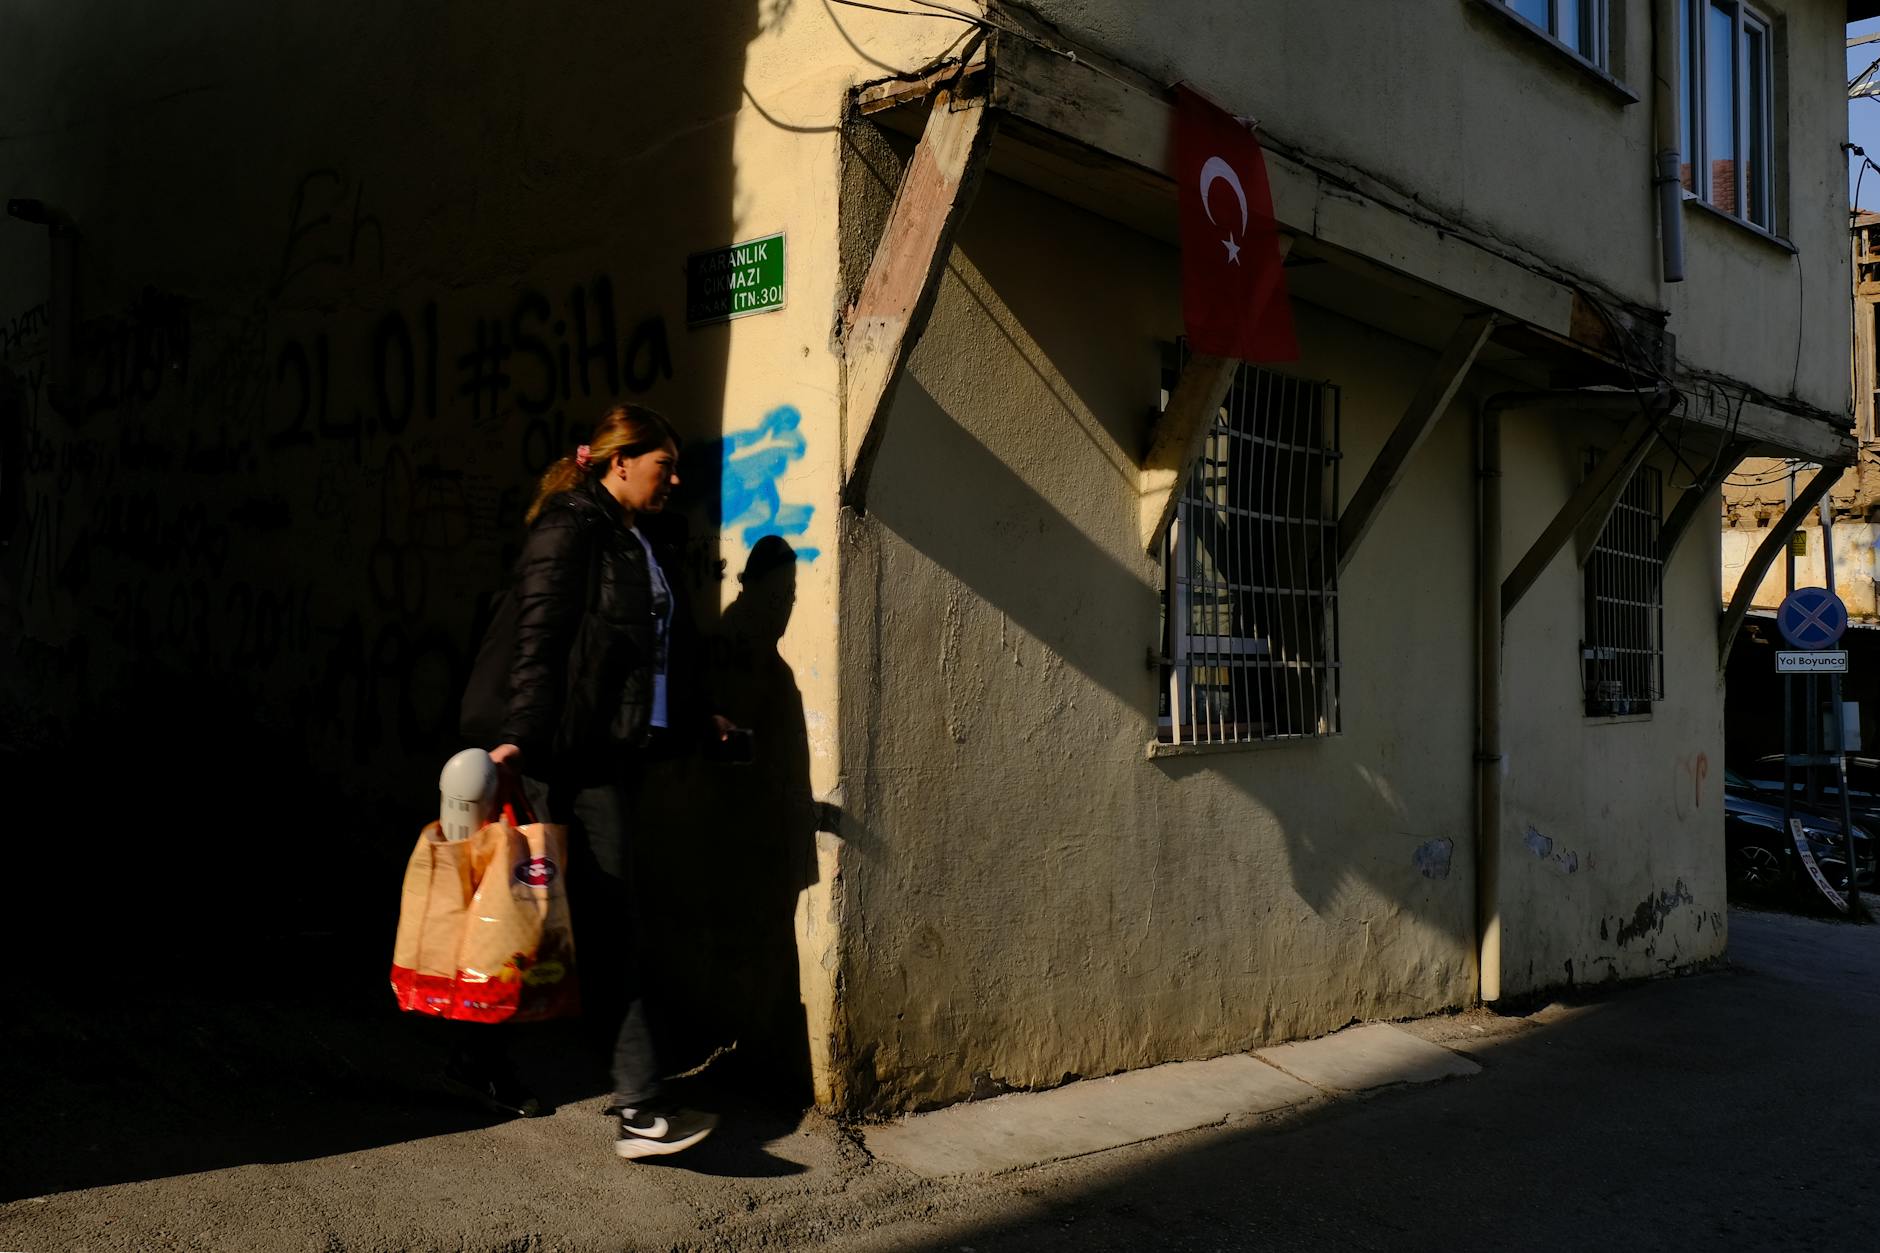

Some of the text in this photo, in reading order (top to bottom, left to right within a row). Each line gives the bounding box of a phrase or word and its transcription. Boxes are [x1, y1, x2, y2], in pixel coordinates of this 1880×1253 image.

[698, 243, 768, 274] KARANLIK
[1780, 657, 1845, 667] Yol Boyunca
